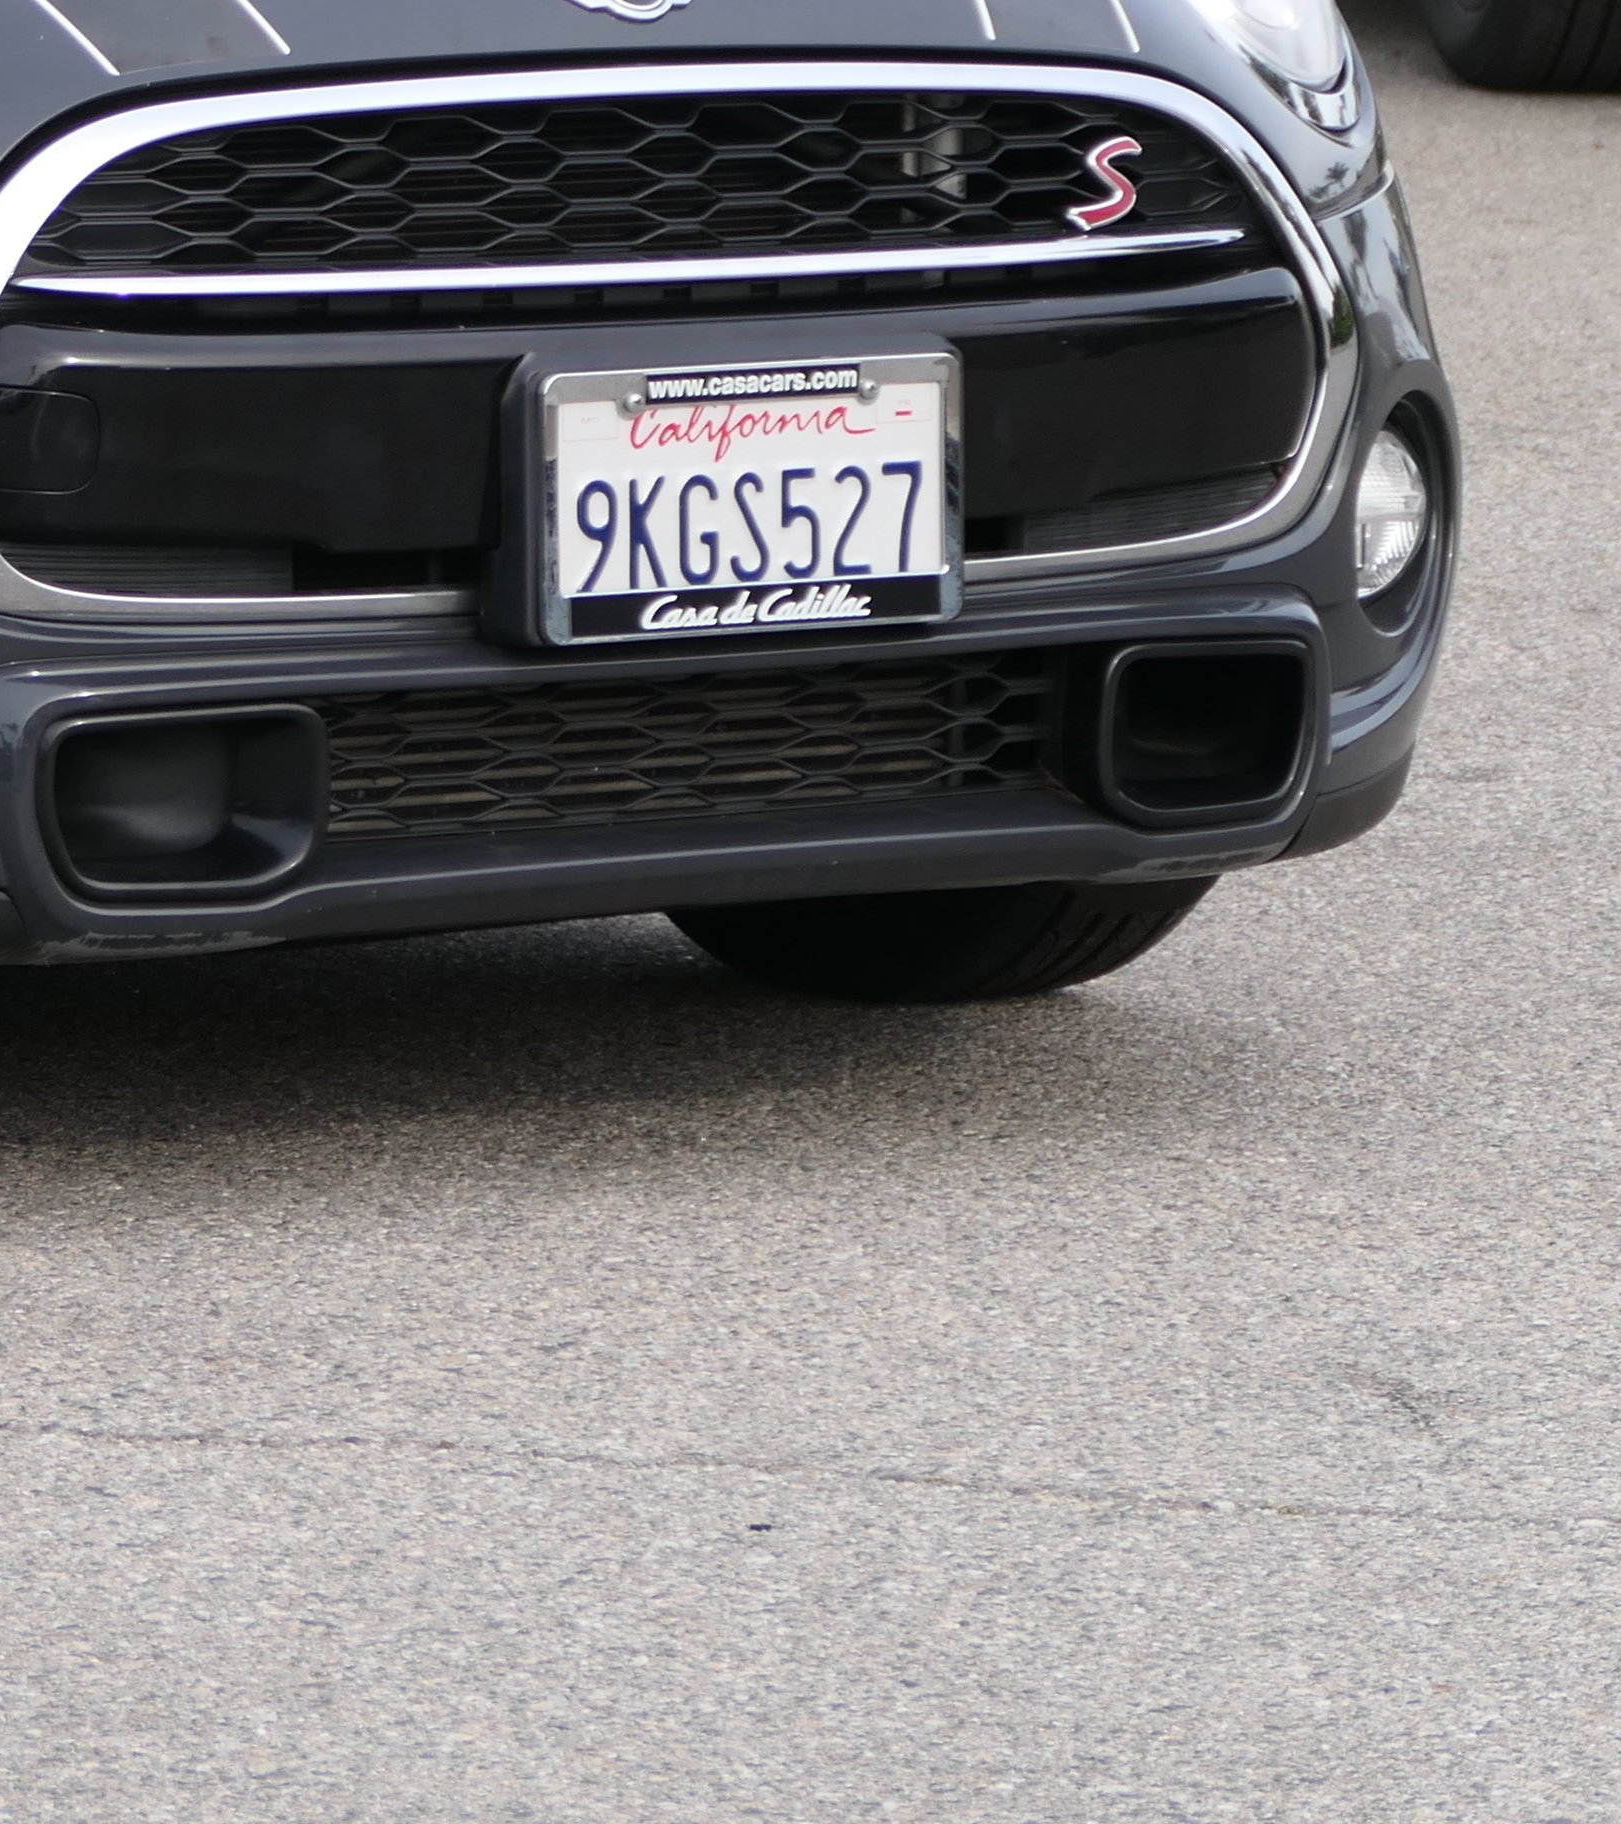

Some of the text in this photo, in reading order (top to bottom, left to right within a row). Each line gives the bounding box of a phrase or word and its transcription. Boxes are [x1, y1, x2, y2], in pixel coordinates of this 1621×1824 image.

[1065, 136, 1143, 232] S
[648, 368, 858, 401] www.casacars.com
[629, 405, 876, 462] California
[575, 459, 924, 594] 9KGS527
[641, 583, 872, 631] Casa de Cadillac
